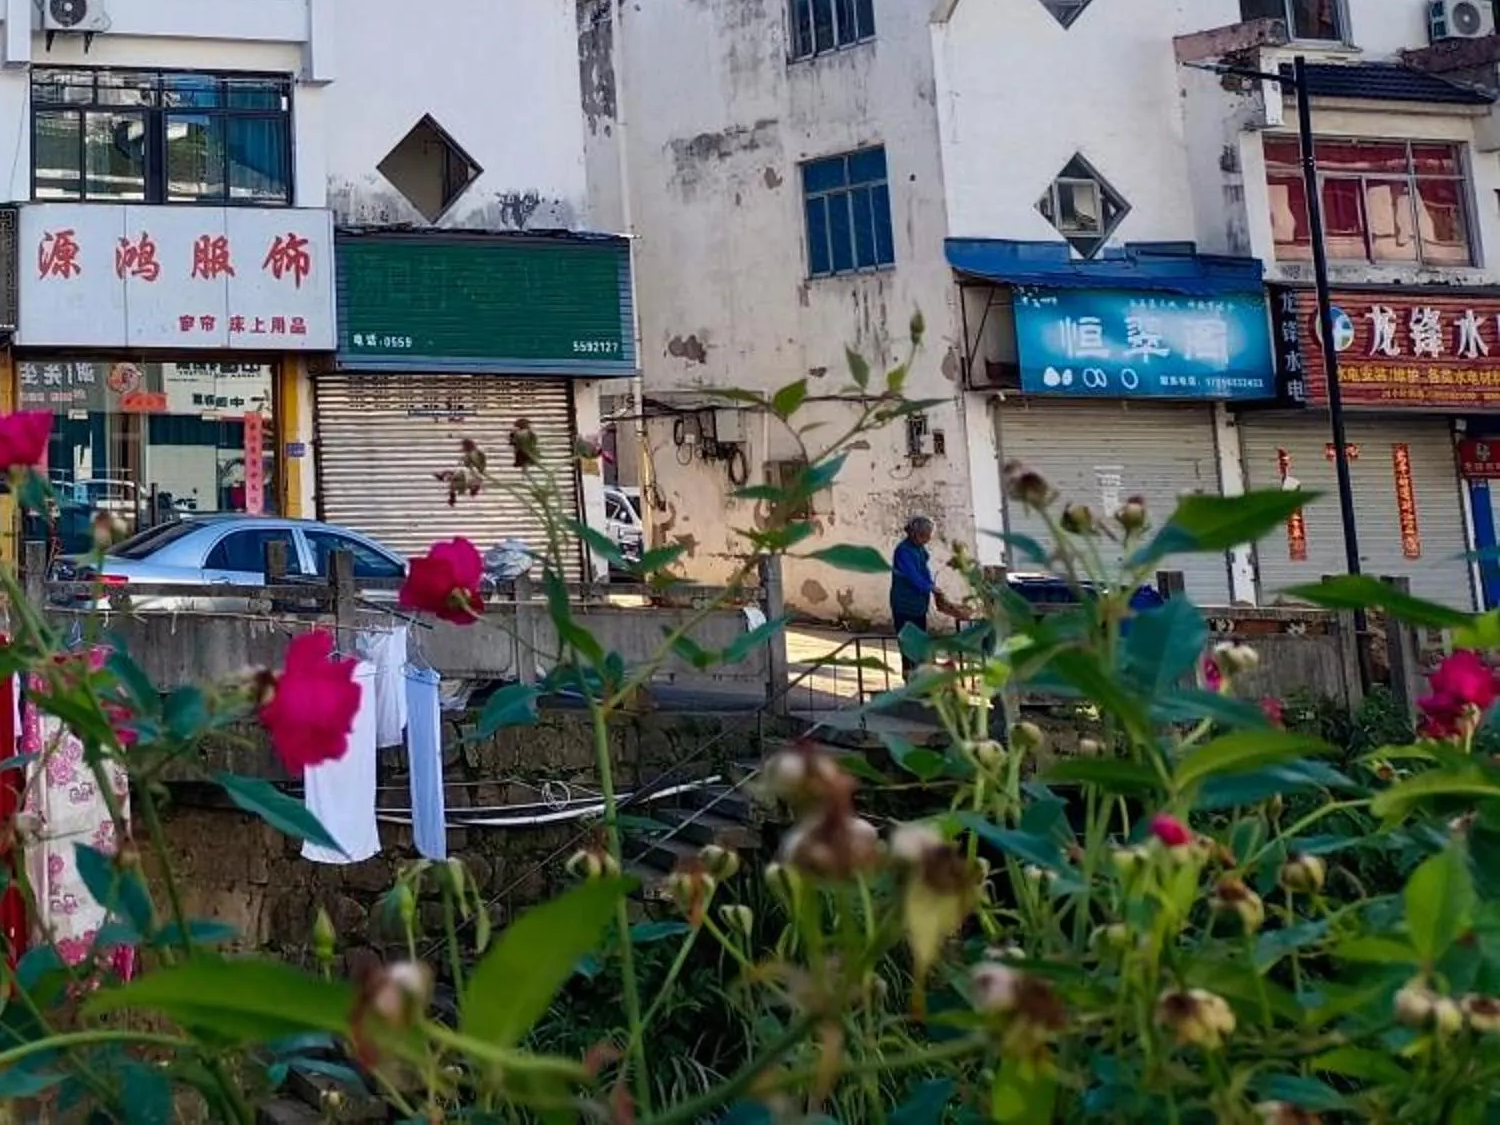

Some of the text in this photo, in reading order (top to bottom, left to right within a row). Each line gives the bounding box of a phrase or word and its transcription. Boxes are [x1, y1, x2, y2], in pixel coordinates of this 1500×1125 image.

[38, 229, 312, 290] 源鸿服饰
[228, 315, 306, 334] 床上用品
[1364, 303, 1500, 359] 龙锋水
[573, 340, 618, 353] 5592127
